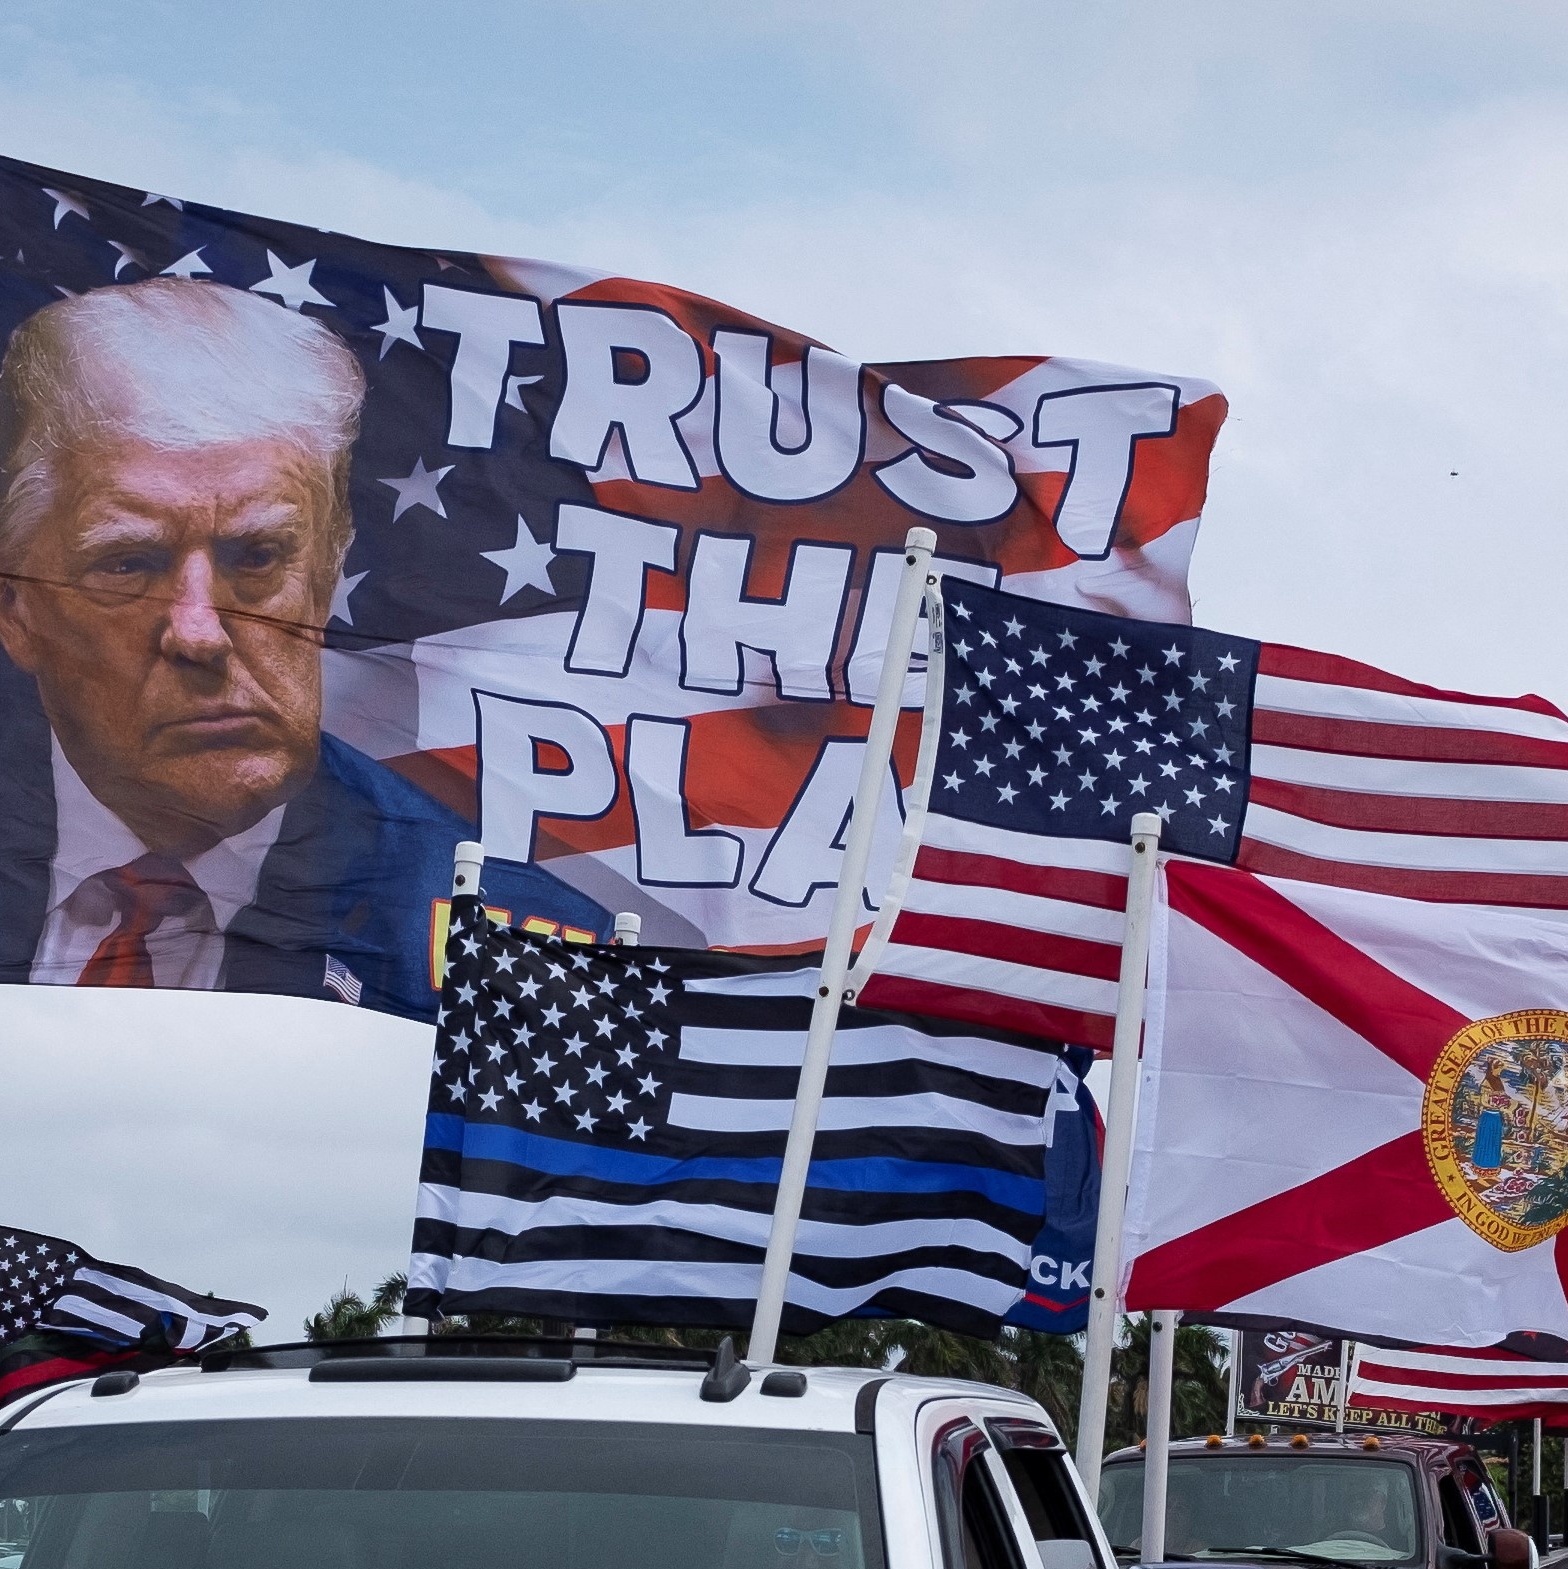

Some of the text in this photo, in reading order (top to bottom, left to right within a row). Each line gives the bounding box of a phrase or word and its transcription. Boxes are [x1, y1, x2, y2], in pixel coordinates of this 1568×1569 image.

[419, 281, 1183, 564] TRUST
[469, 687, 921, 913] PLA
[1479, 1020, 1506, 1039] OF
[1508, 1017, 1559, 1036] THE
[1440, 1031, 1483, 1080] SEAL
[1431, 1079, 1451, 1163] GREAT
[1454, 1190, 1478, 1213] IN
[1474, 1207, 1511, 1242] GOD
[1266, 1400, 1319, 1420] LET'S
[1376, 1410, 1412, 1429] ALL
